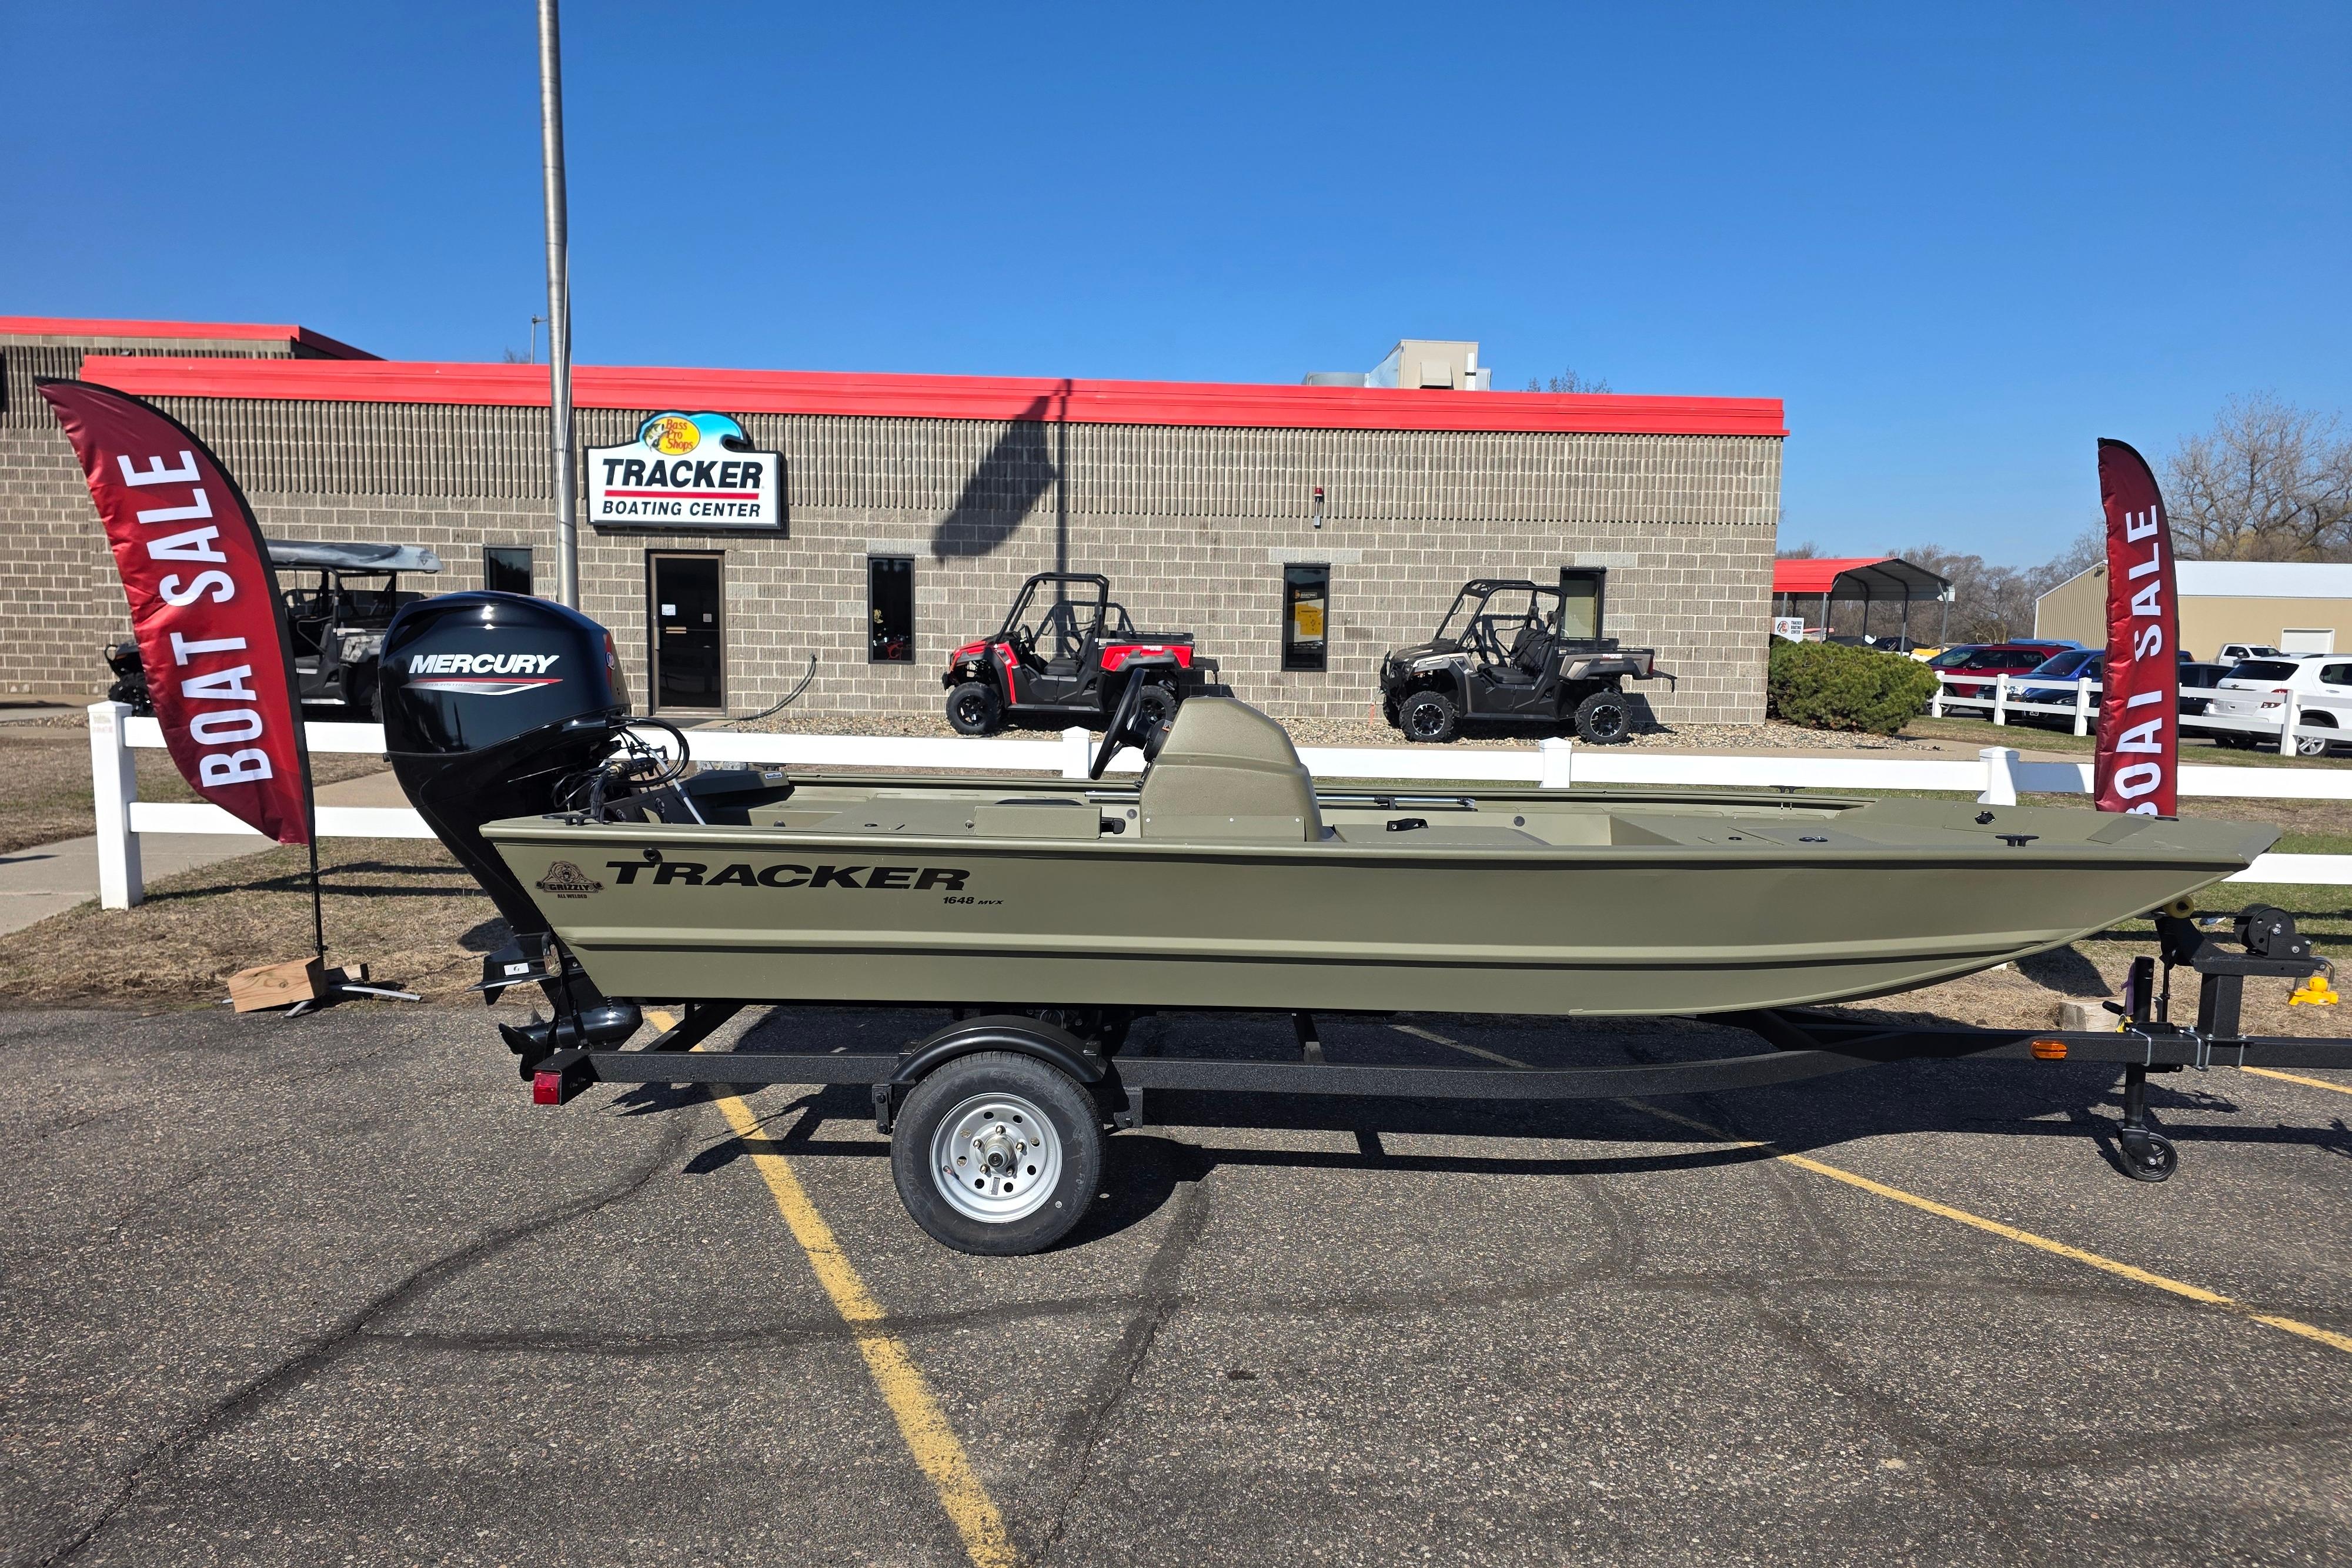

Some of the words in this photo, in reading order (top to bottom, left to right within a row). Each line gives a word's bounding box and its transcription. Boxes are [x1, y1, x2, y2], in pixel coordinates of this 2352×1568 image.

[666, 419, 688, 430] Bass
[667, 429, 683, 440] Pro
[666, 439, 694, 452] Shops
[602, 459, 763, 489] TRACKER
[602, 500, 681, 516] BOATING
[690, 502, 761, 517] CENTER
[117, 450, 235, 607] SALE
[2126, 504, 2163, 663] SALE
[409, 654, 560, 674] MERCURY
[169, 631, 273, 788] BOAT
[606, 861, 971, 891] TRACKER
